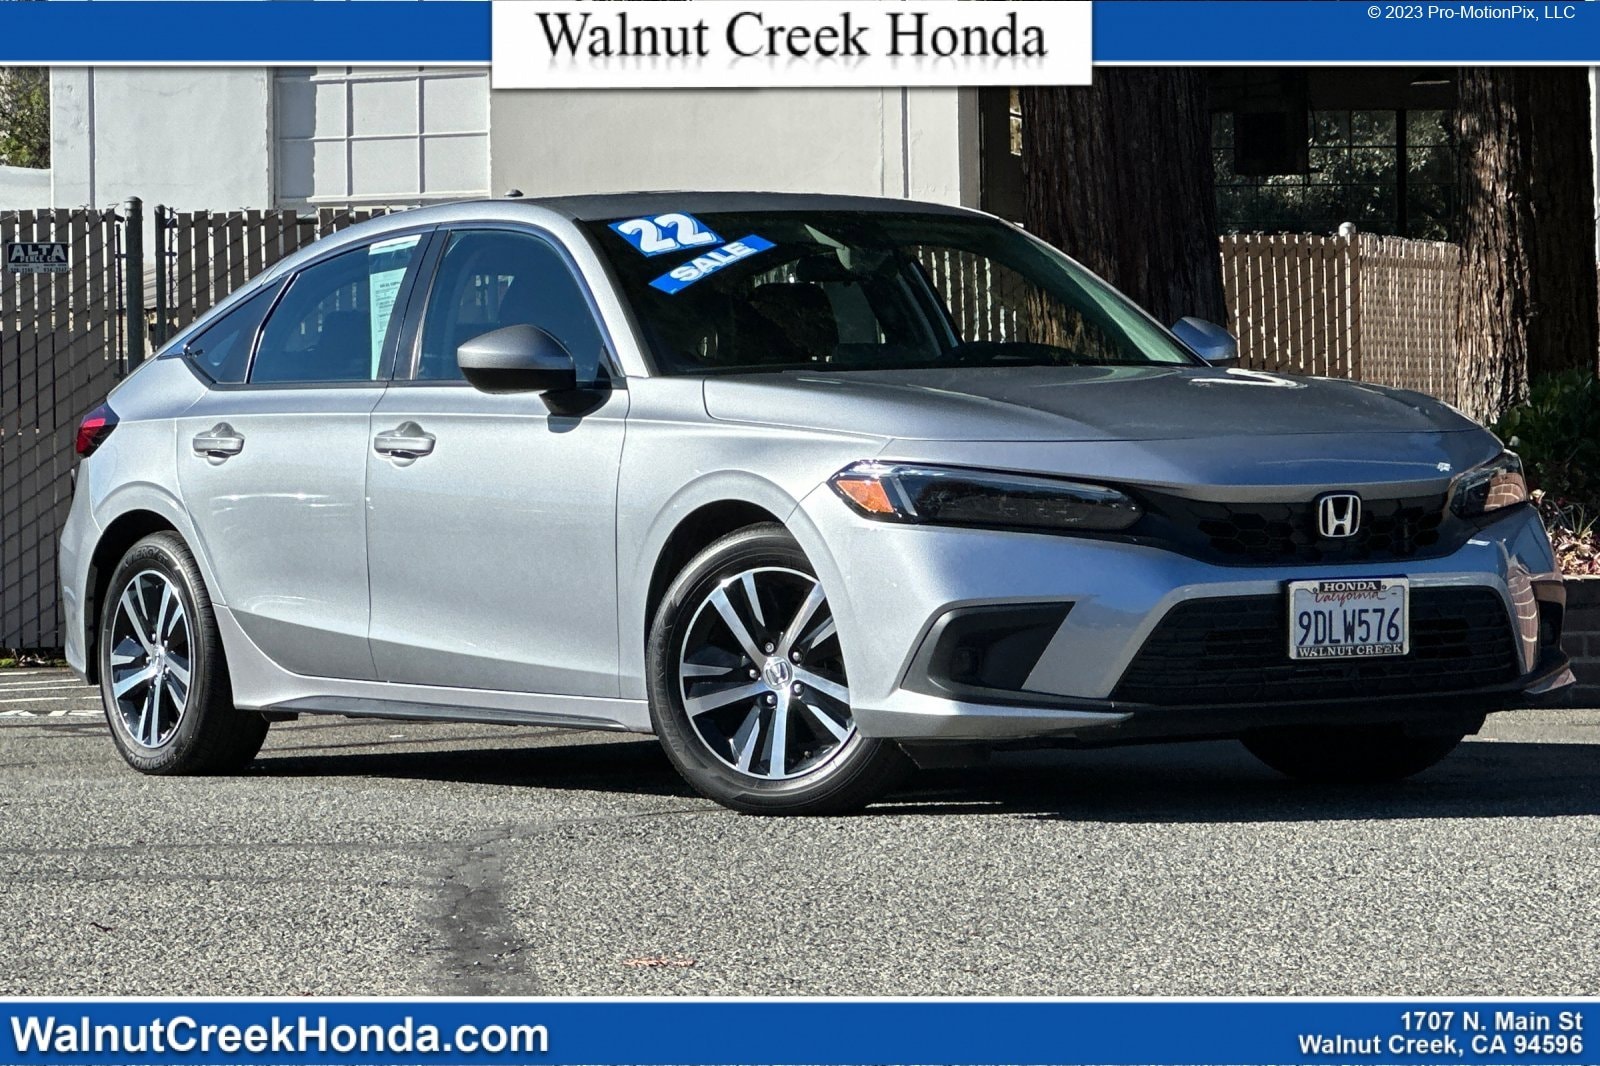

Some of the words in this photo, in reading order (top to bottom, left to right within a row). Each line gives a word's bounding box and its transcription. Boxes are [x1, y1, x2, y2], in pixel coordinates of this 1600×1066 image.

[617, 213, 717, 254] 22
[10, 244, 66, 262] ALTA
[669, 241, 758, 283] SALE
[1323, 582, 1377, 592] HONDA
[1298, 607, 1400, 646] 9DLW576
[1299, 646, 1354, 657] WALNUT
[1356, 643, 1402, 656] CREEK
